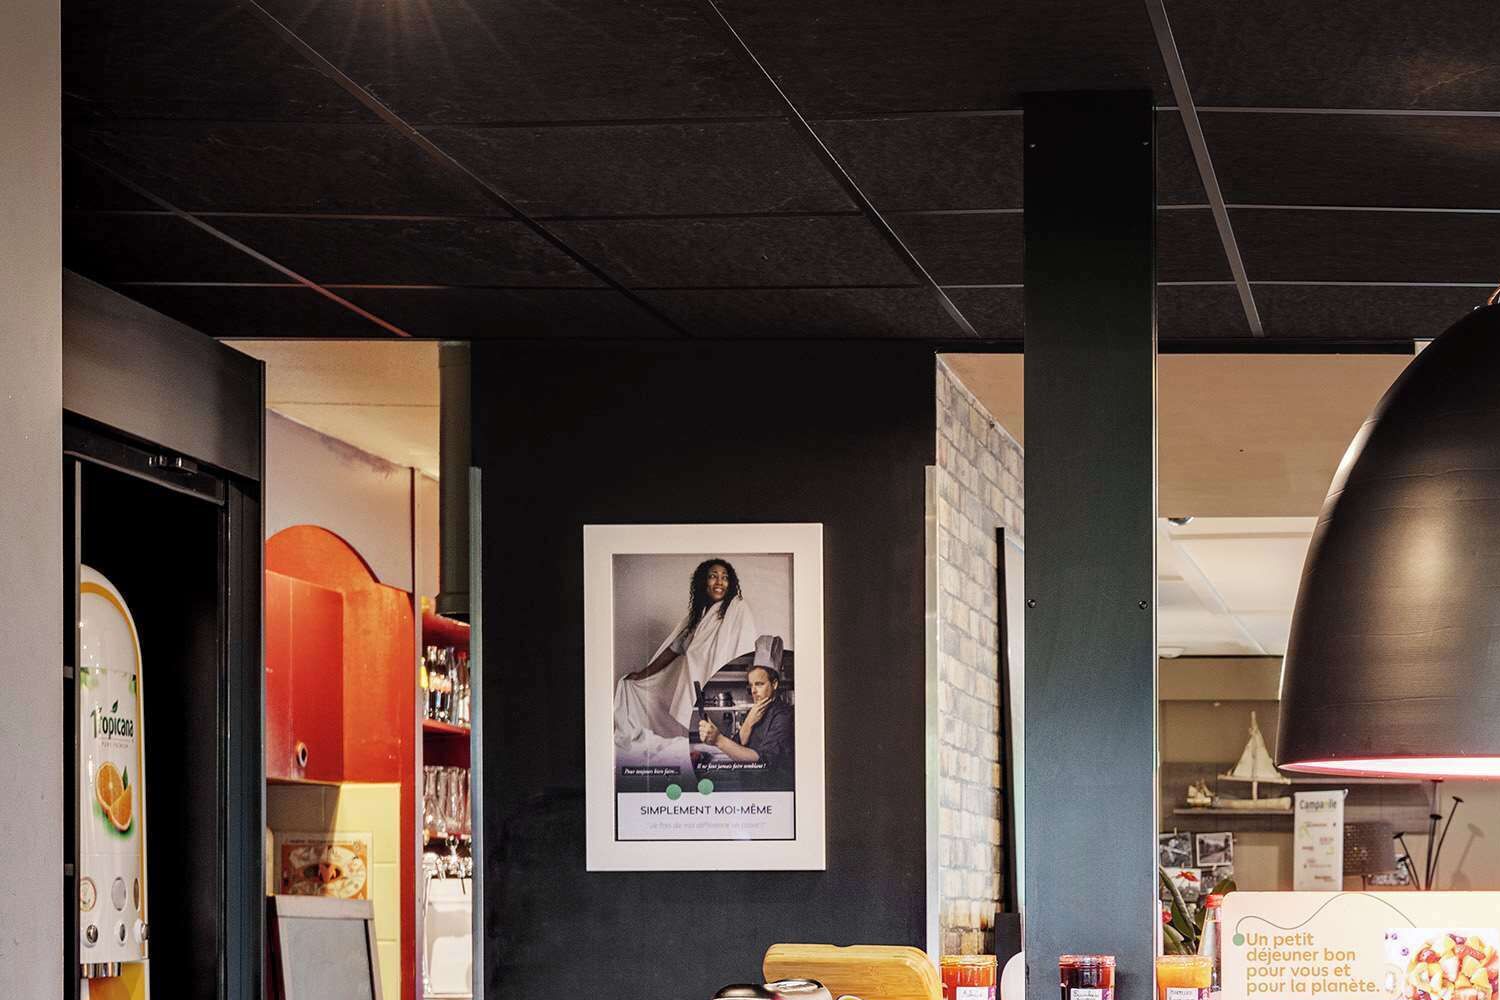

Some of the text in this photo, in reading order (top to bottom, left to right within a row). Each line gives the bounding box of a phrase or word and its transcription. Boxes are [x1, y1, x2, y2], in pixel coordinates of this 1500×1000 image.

[640, 802, 774, 816] SIMPLEMENT MOI-MÊME
[1246, 932, 1314, 949] Un petit
[1246, 947, 1356, 965] déjeuner bon
[1246, 963, 1352, 980] pour vous et
[1246, 979, 1381, 996] pour la planète.
